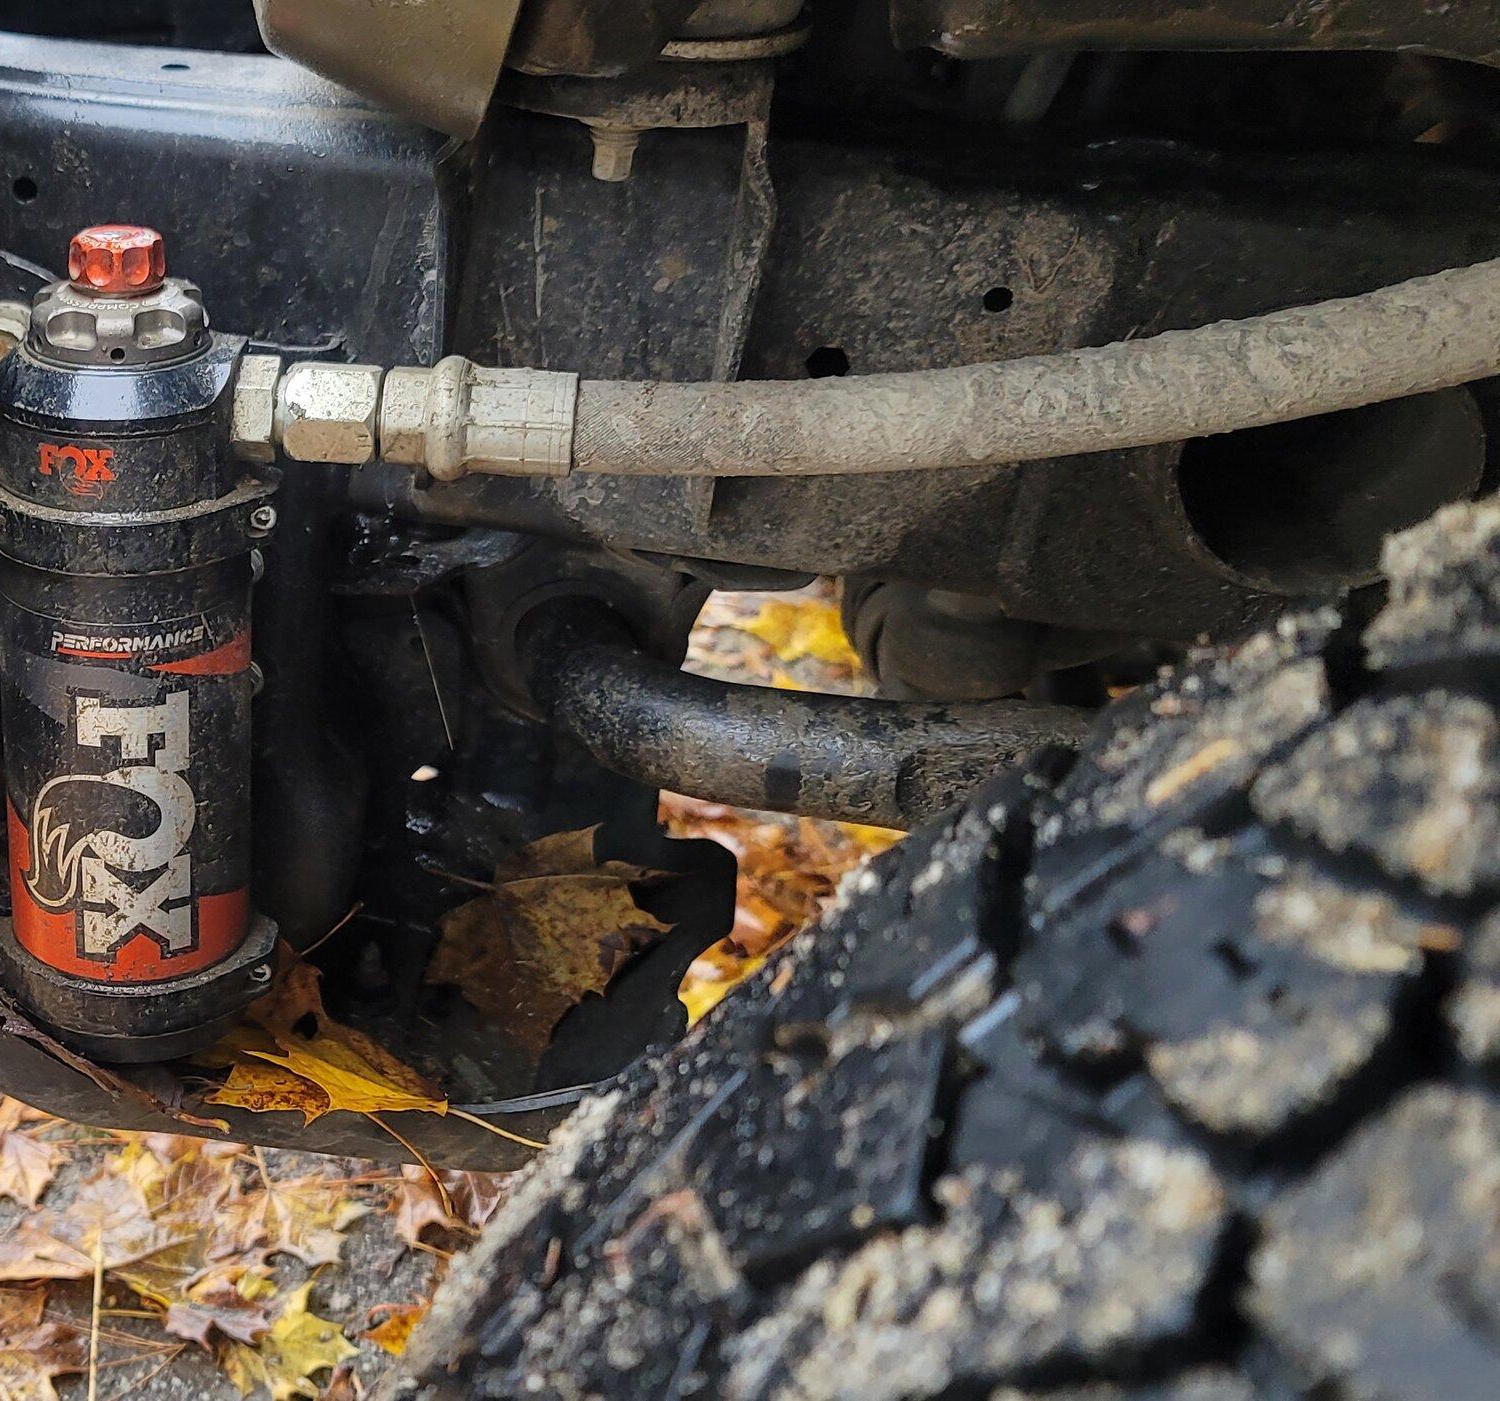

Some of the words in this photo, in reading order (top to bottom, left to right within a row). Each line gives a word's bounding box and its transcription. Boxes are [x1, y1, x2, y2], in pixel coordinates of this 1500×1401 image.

[38, 443, 116, 500] FOX
[50, 625, 204, 652] PERFORMANCE
[28, 690, 196, 954] FOX
